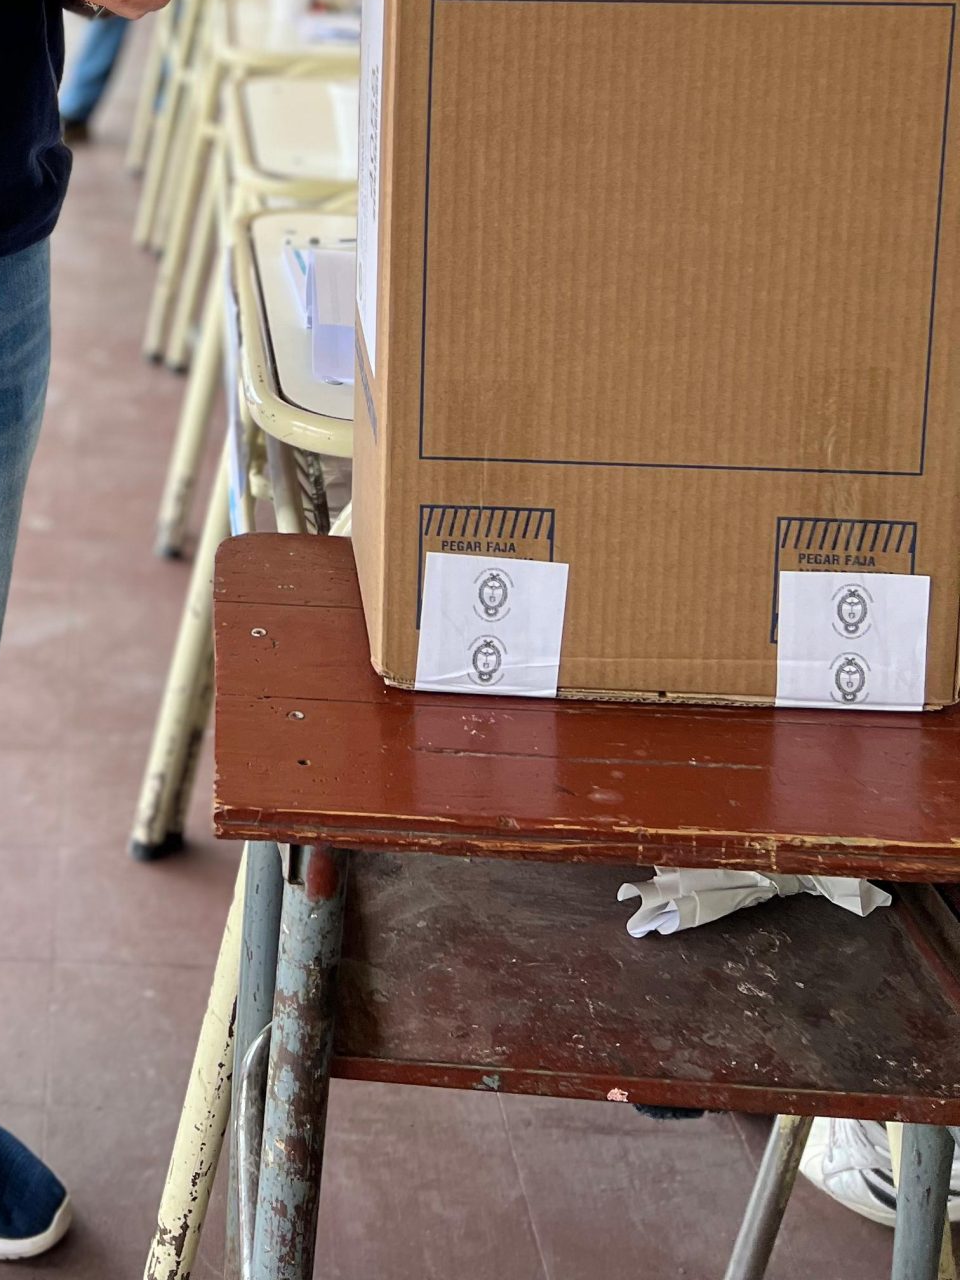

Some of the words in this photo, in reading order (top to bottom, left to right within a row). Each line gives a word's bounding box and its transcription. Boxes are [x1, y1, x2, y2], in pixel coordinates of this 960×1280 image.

[441, 540, 482, 551] PEGAR
[486, 542, 516, 553] FAJA
[798, 553, 840, 565] PEGAR
[844, 555, 876, 566] FAJA
